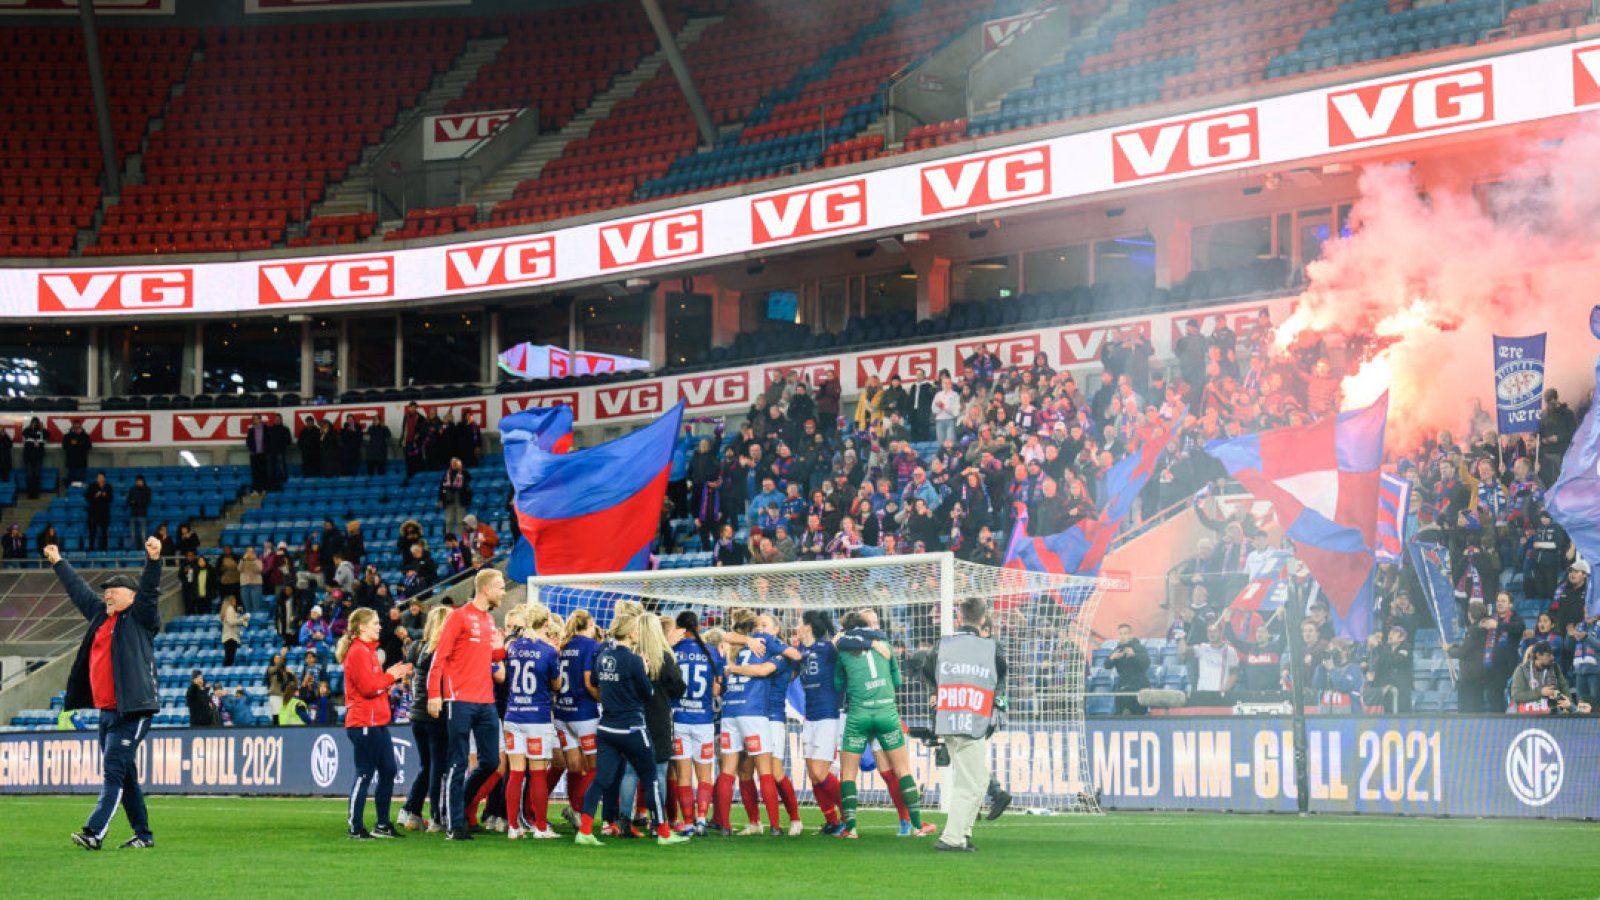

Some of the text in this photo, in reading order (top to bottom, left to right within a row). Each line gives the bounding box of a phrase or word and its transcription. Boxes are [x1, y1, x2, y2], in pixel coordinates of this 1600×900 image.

[42, 71, 1484, 309] VG VG VG VG VG VG VG VG
[600, 387, 660, 415] VG
[681, 375, 745, 405] VG
[688, 653, 708, 662] OBO
[862, 650, 877, 679] 1
[941, 661, 990, 679] Canon
[511, 659, 537, 695] 26
[680, 663, 708, 698] 15
[938, 687, 984, 710] PHOTO
[948, 714, 972, 731] 108
[153, 738, 236, 785] NM-GULL
[242, 736, 283, 785] 2021
[985, 731, 1084, 793] TBALL
[1093, 731, 1161, 796] MED
[1172, 730, 1348, 799] NM-GULL
[1360, 730, 1442, 800] 2021
